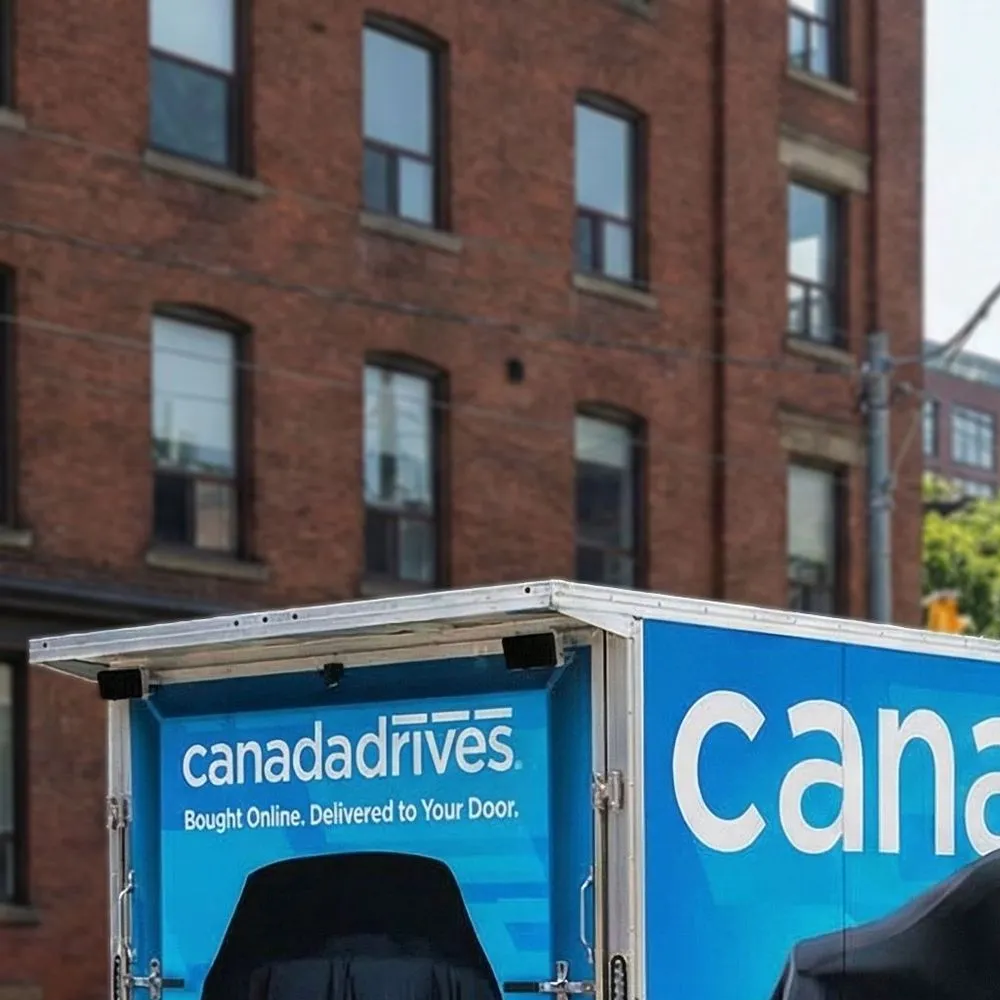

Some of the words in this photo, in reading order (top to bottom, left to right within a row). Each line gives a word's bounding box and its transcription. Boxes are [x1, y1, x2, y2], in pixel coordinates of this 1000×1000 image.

[182, 707, 515, 788] canadadrives
[184, 808, 243, 834] Bought
[246, 803, 306, 828] Online.
[310, 798, 394, 826] Delivered
[398, 800, 418, 823] to
[421, 799, 465, 821] Your
[467, 796, 520, 819] Door.
